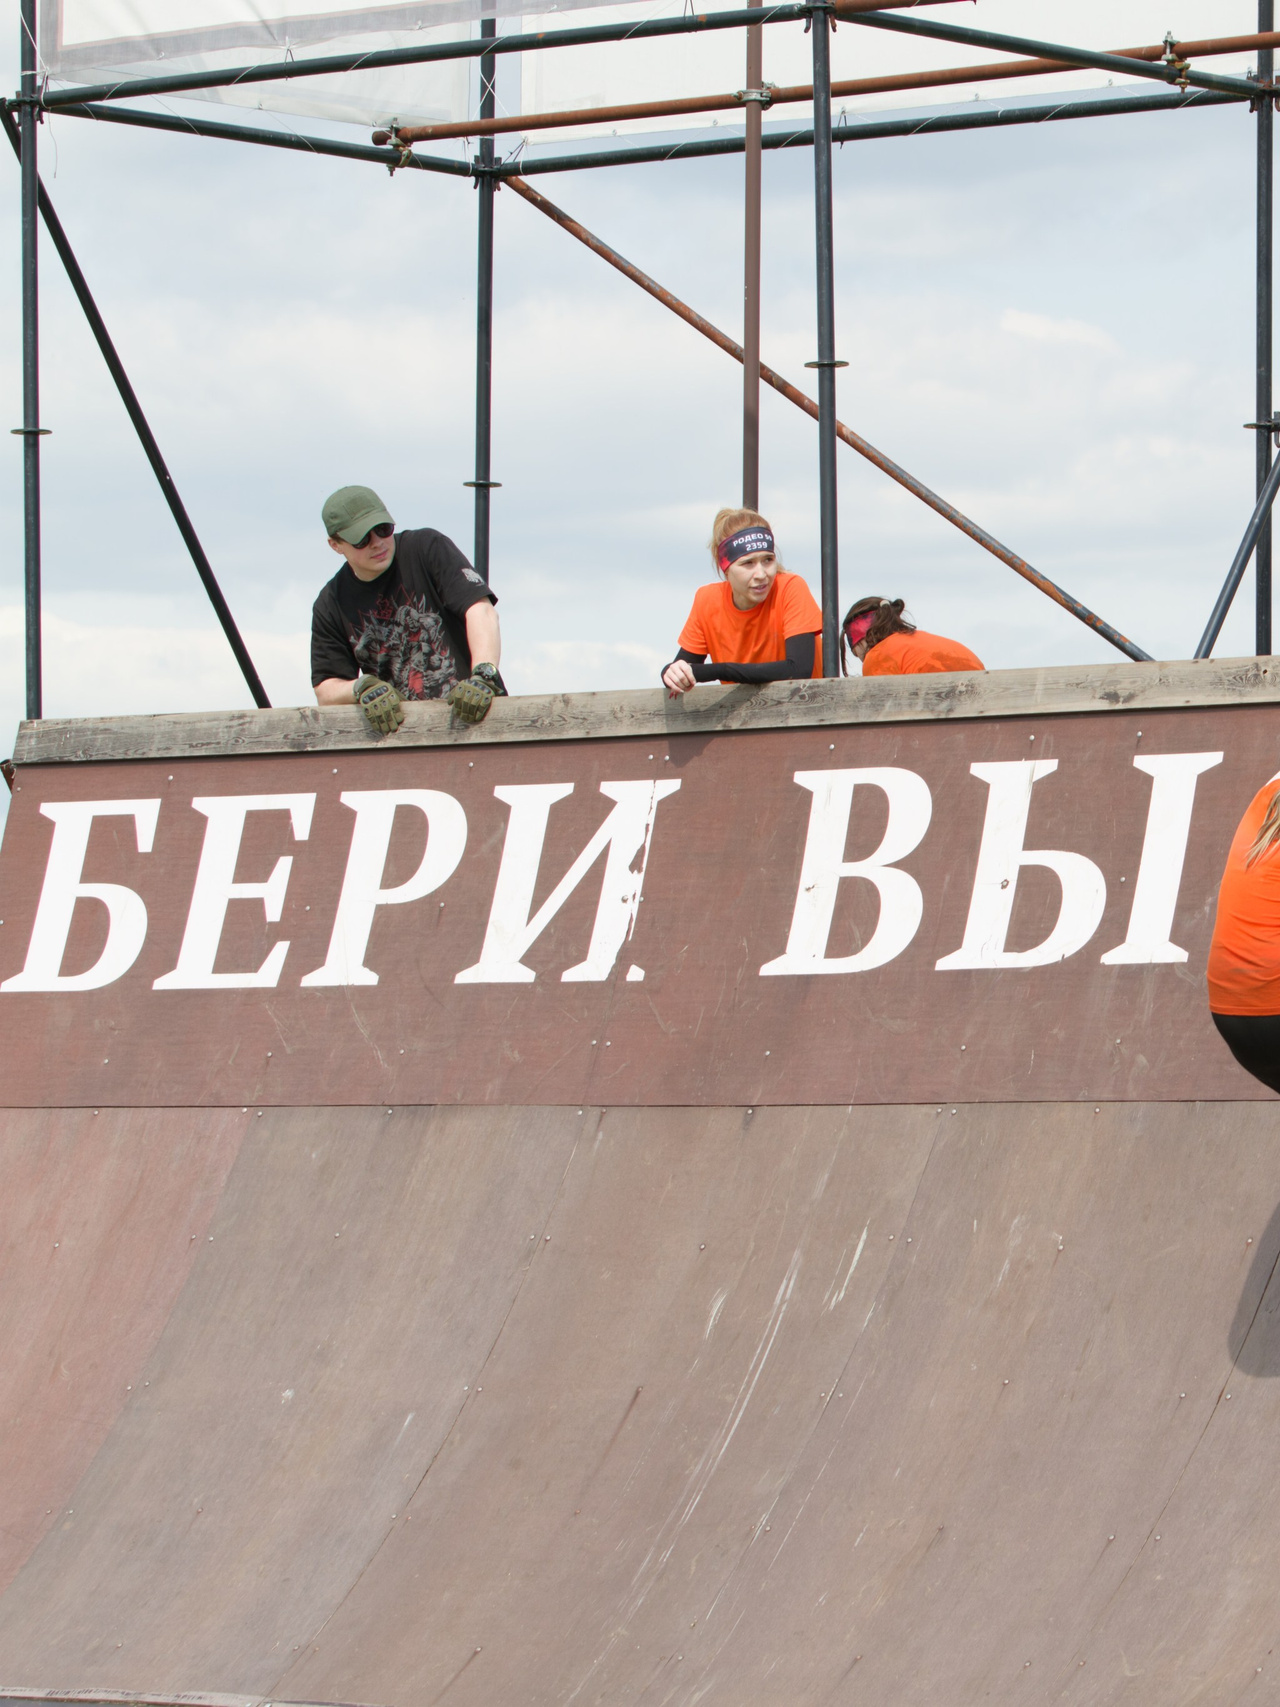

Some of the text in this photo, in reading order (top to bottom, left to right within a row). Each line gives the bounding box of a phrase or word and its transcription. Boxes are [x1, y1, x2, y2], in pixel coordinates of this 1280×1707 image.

[732, 533, 764, 547] РОДЕО
[745, 541, 768, 552] 2359
[0, 778, 682, 993] БЕРИ
